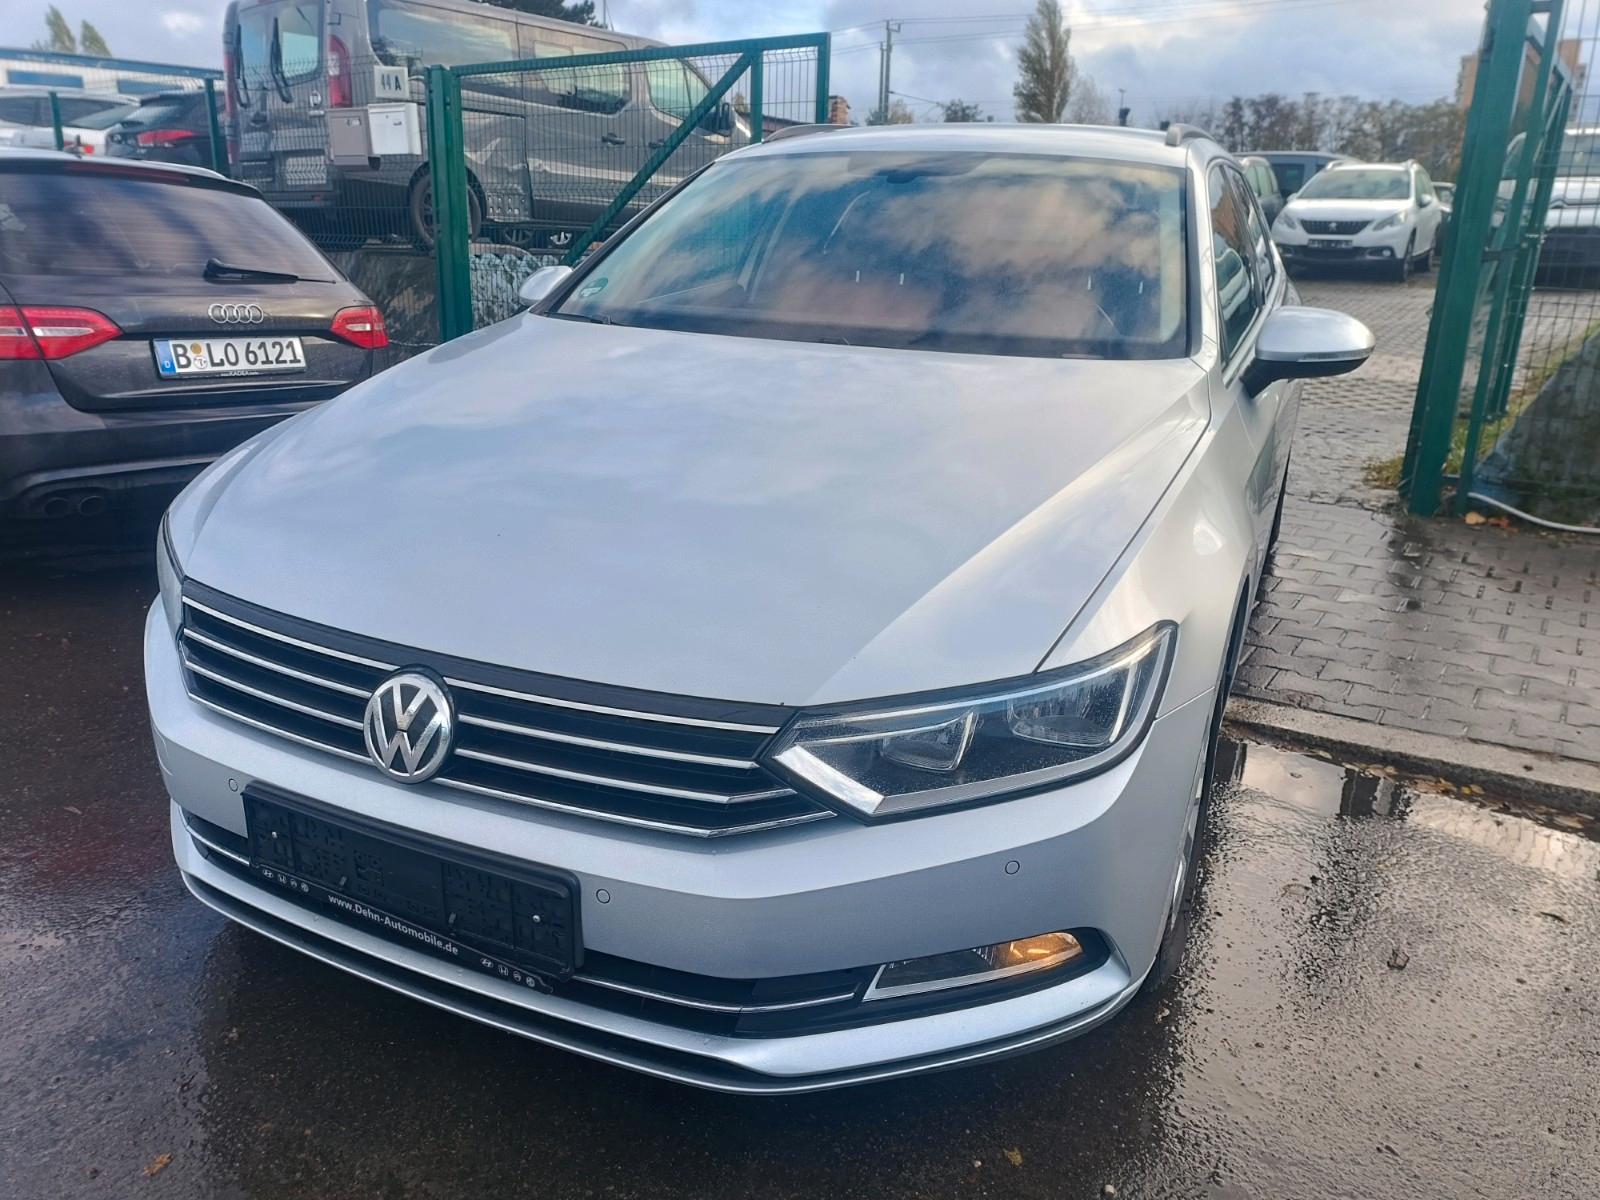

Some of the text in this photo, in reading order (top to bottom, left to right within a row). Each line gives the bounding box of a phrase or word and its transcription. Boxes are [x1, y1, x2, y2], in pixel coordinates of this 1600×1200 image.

[394, 75, 402, 91] A
[164, 360, 171, 369] D
[172, 340, 301, 369] B LO 6121
[327, 894, 459, 956] www.Dehn-Automobile.de
